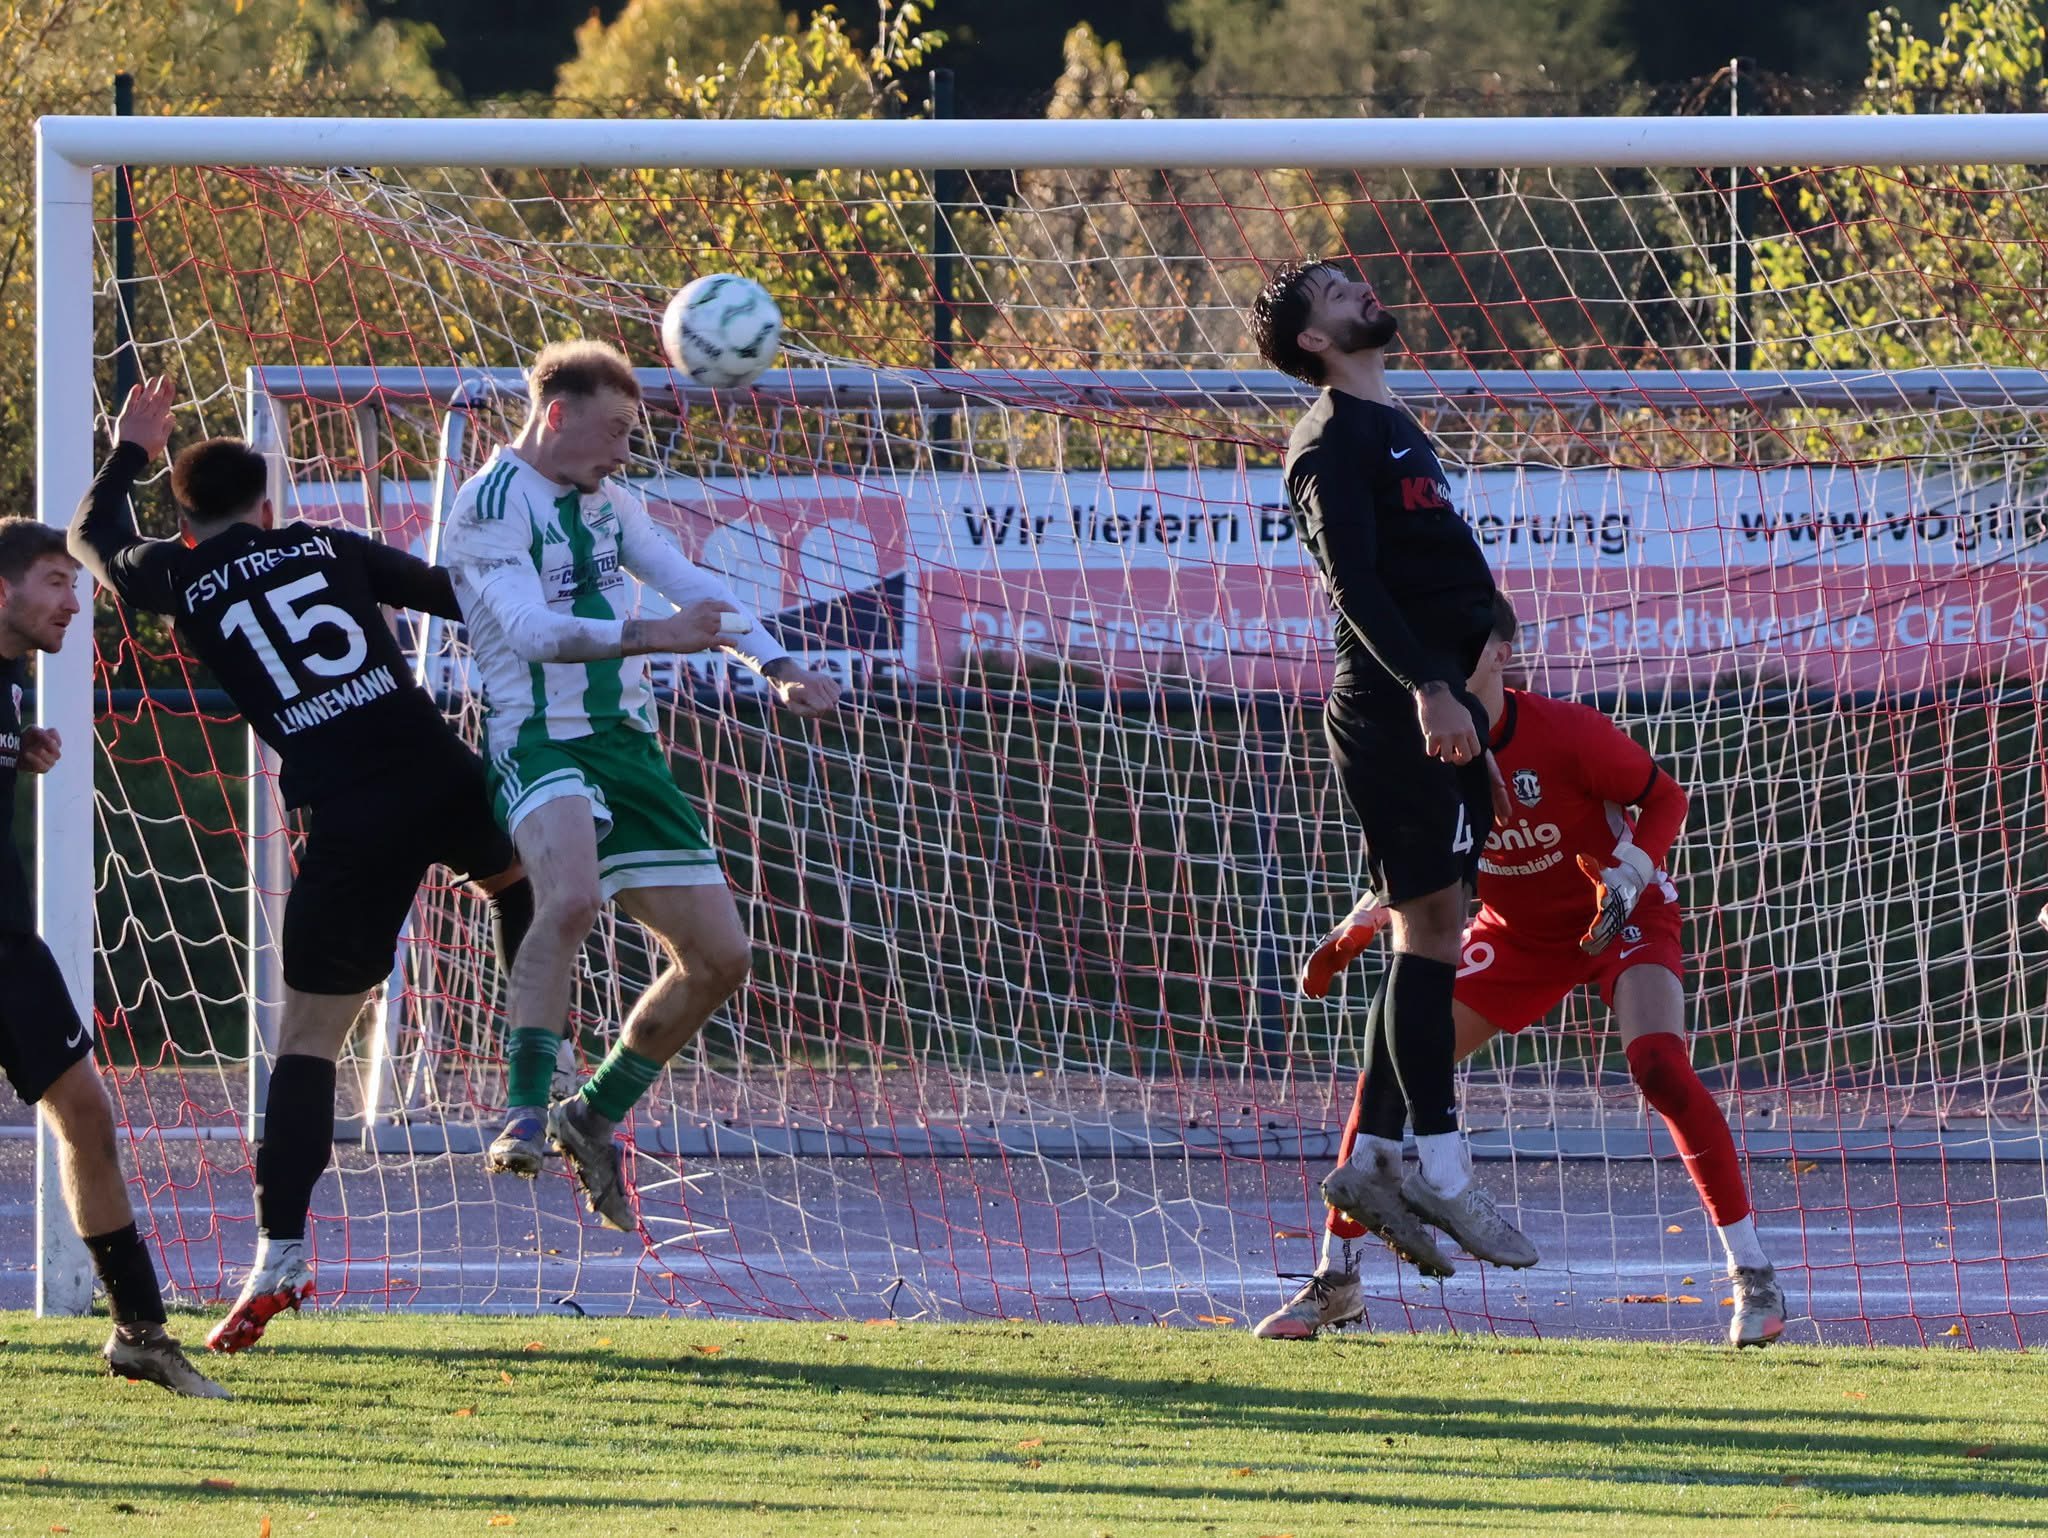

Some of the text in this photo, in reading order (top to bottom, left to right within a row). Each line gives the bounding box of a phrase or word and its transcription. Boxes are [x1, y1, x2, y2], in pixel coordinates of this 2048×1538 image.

[964, 505, 1053, 545] Wir
[1073, 504, 1238, 545] liefern
[184, 563, 230, 614] FSV
[220, 571, 368, 700] 15
[960, 609, 1047, 651] Die
[1575, 606, 1875, 650] Stadtwerke
[273, 665, 398, 735] LINNEMANN
[1452, 802, 1475, 854] 4
[1456, 928, 1496, 979] 9
